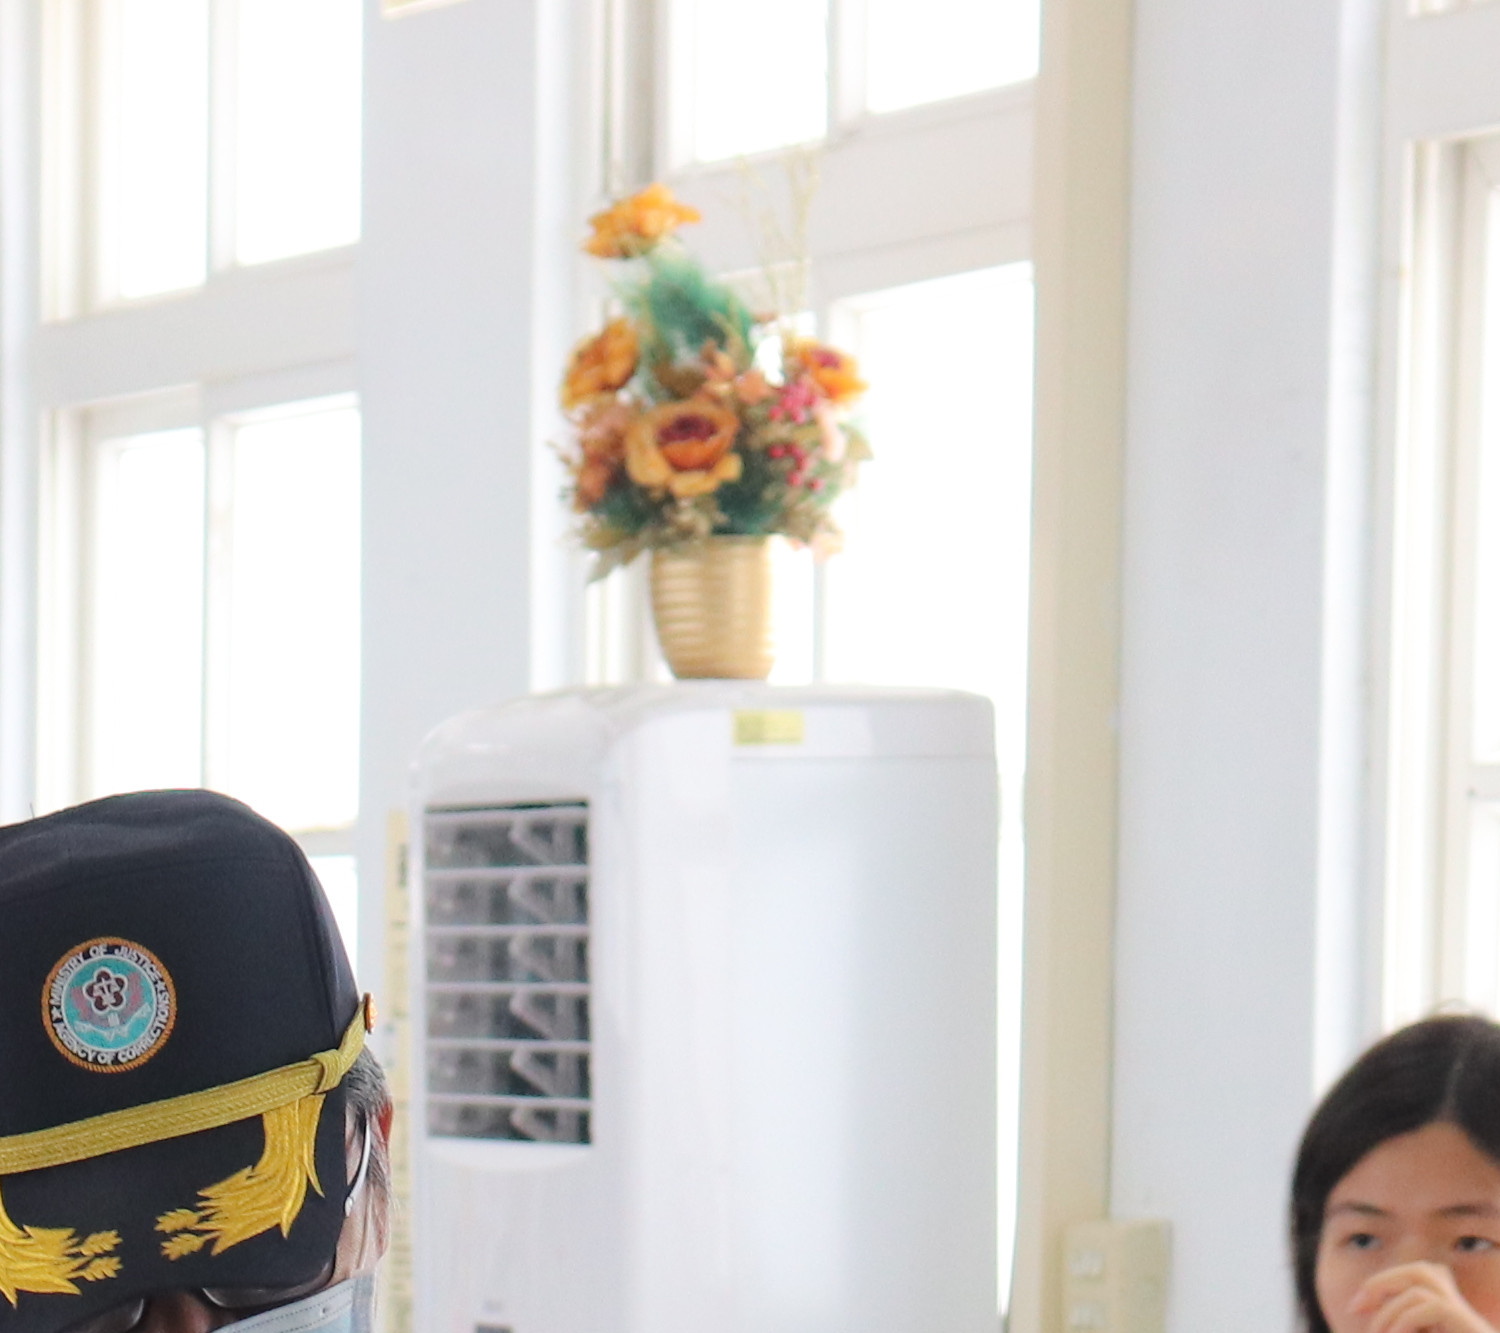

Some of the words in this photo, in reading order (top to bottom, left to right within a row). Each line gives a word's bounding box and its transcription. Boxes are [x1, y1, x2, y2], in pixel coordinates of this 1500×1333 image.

[50, 952, 85, 1006] MINISTRY
[90, 944, 108, 957] OF
[114, 946, 162, 981] JUSTICE
[53, 1022, 97, 1062] AGENCY
[97, 1053, 114, 1065] OF
[117, 990, 170, 1063] CORRECTIONS
